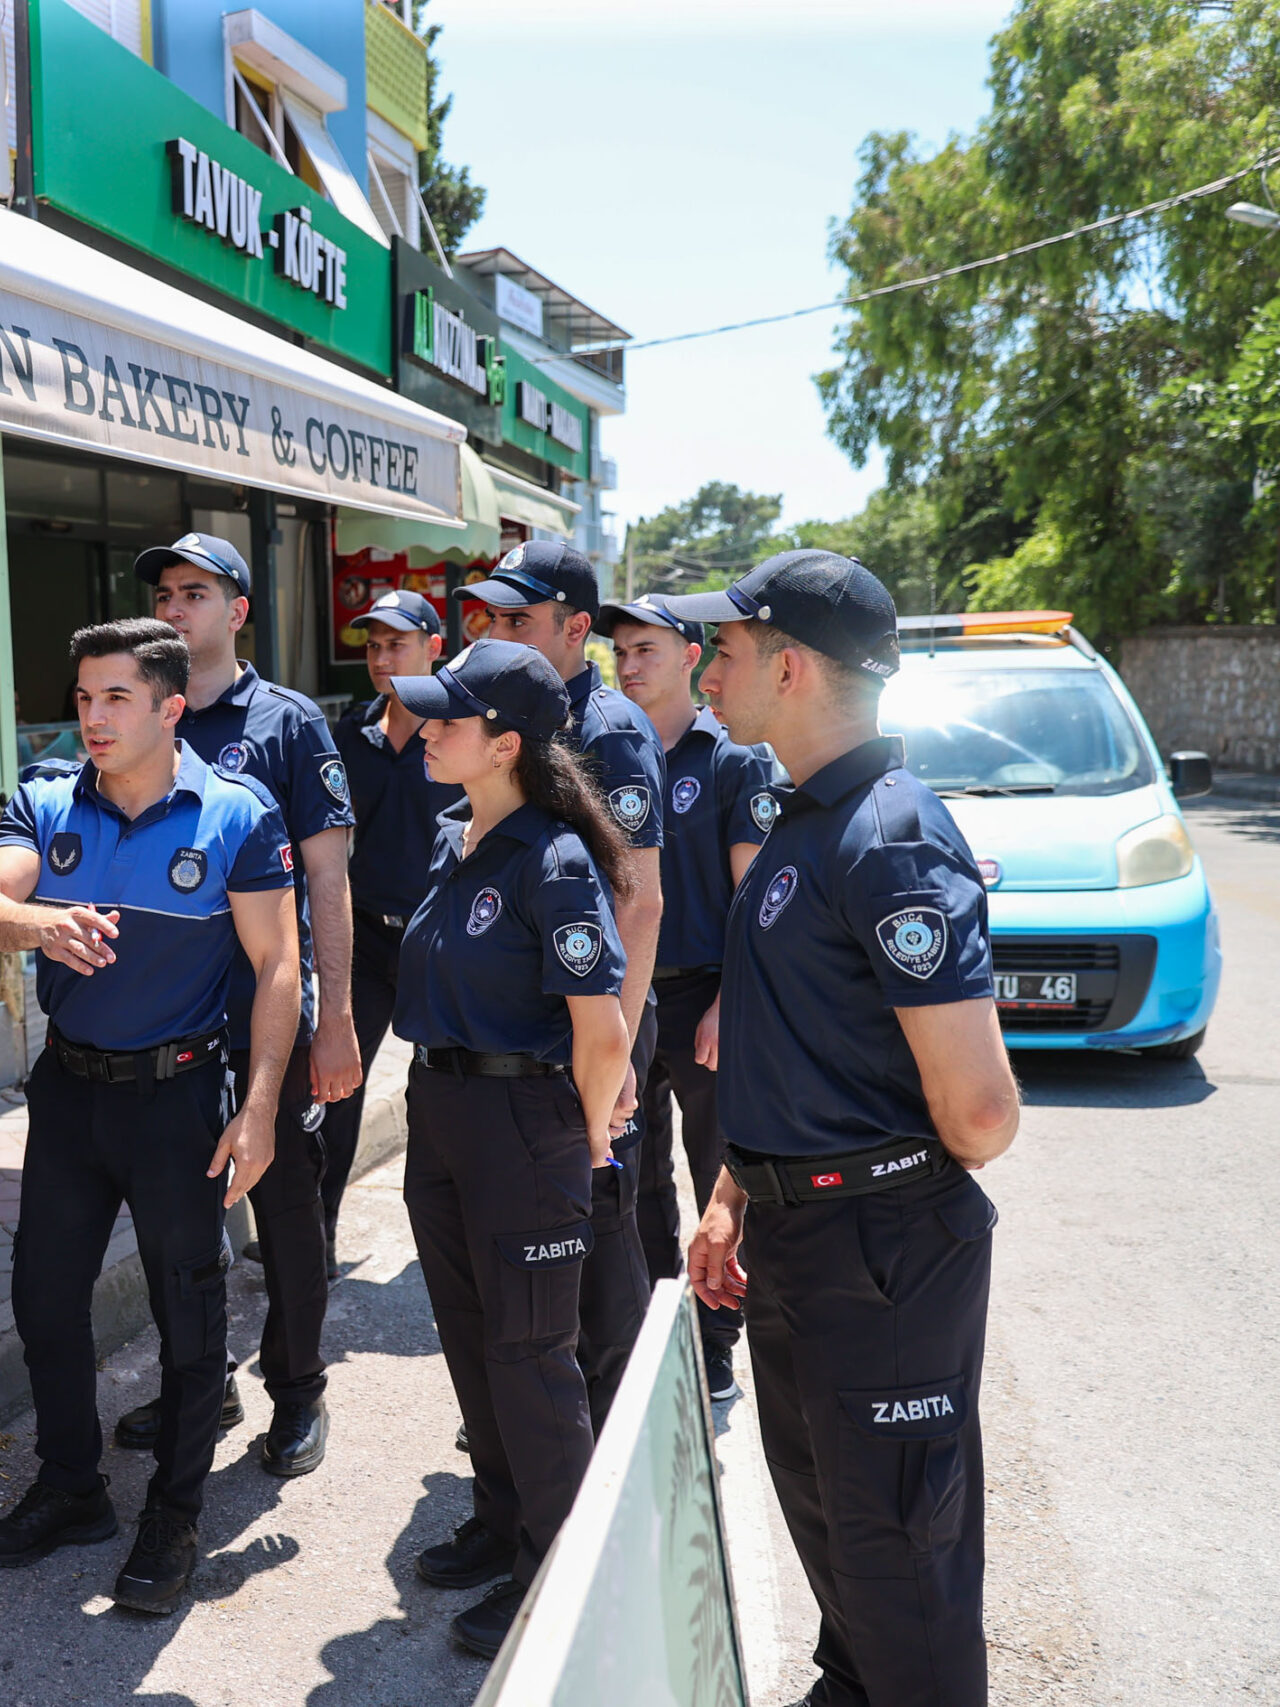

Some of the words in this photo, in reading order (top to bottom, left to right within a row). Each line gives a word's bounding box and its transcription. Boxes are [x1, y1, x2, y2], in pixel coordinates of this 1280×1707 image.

[177, 137, 264, 259] TAVUK
[284, 205, 347, 310] KÖFTE
[52, 337, 250, 457] BAKERY
[271, 405, 297, 468] &
[306, 416, 418, 496] COFFEE
[565, 926, 588, 936] BUCA
[892, 913, 924, 928] BUCA
[912, 962, 933, 973] 1923
[1039, 976, 1071, 1000] 46
[870, 1149, 931, 1177] ZABIT
[523, 1237, 587, 1262] ZABITA
[871, 1394, 955, 1423] ZABITA
